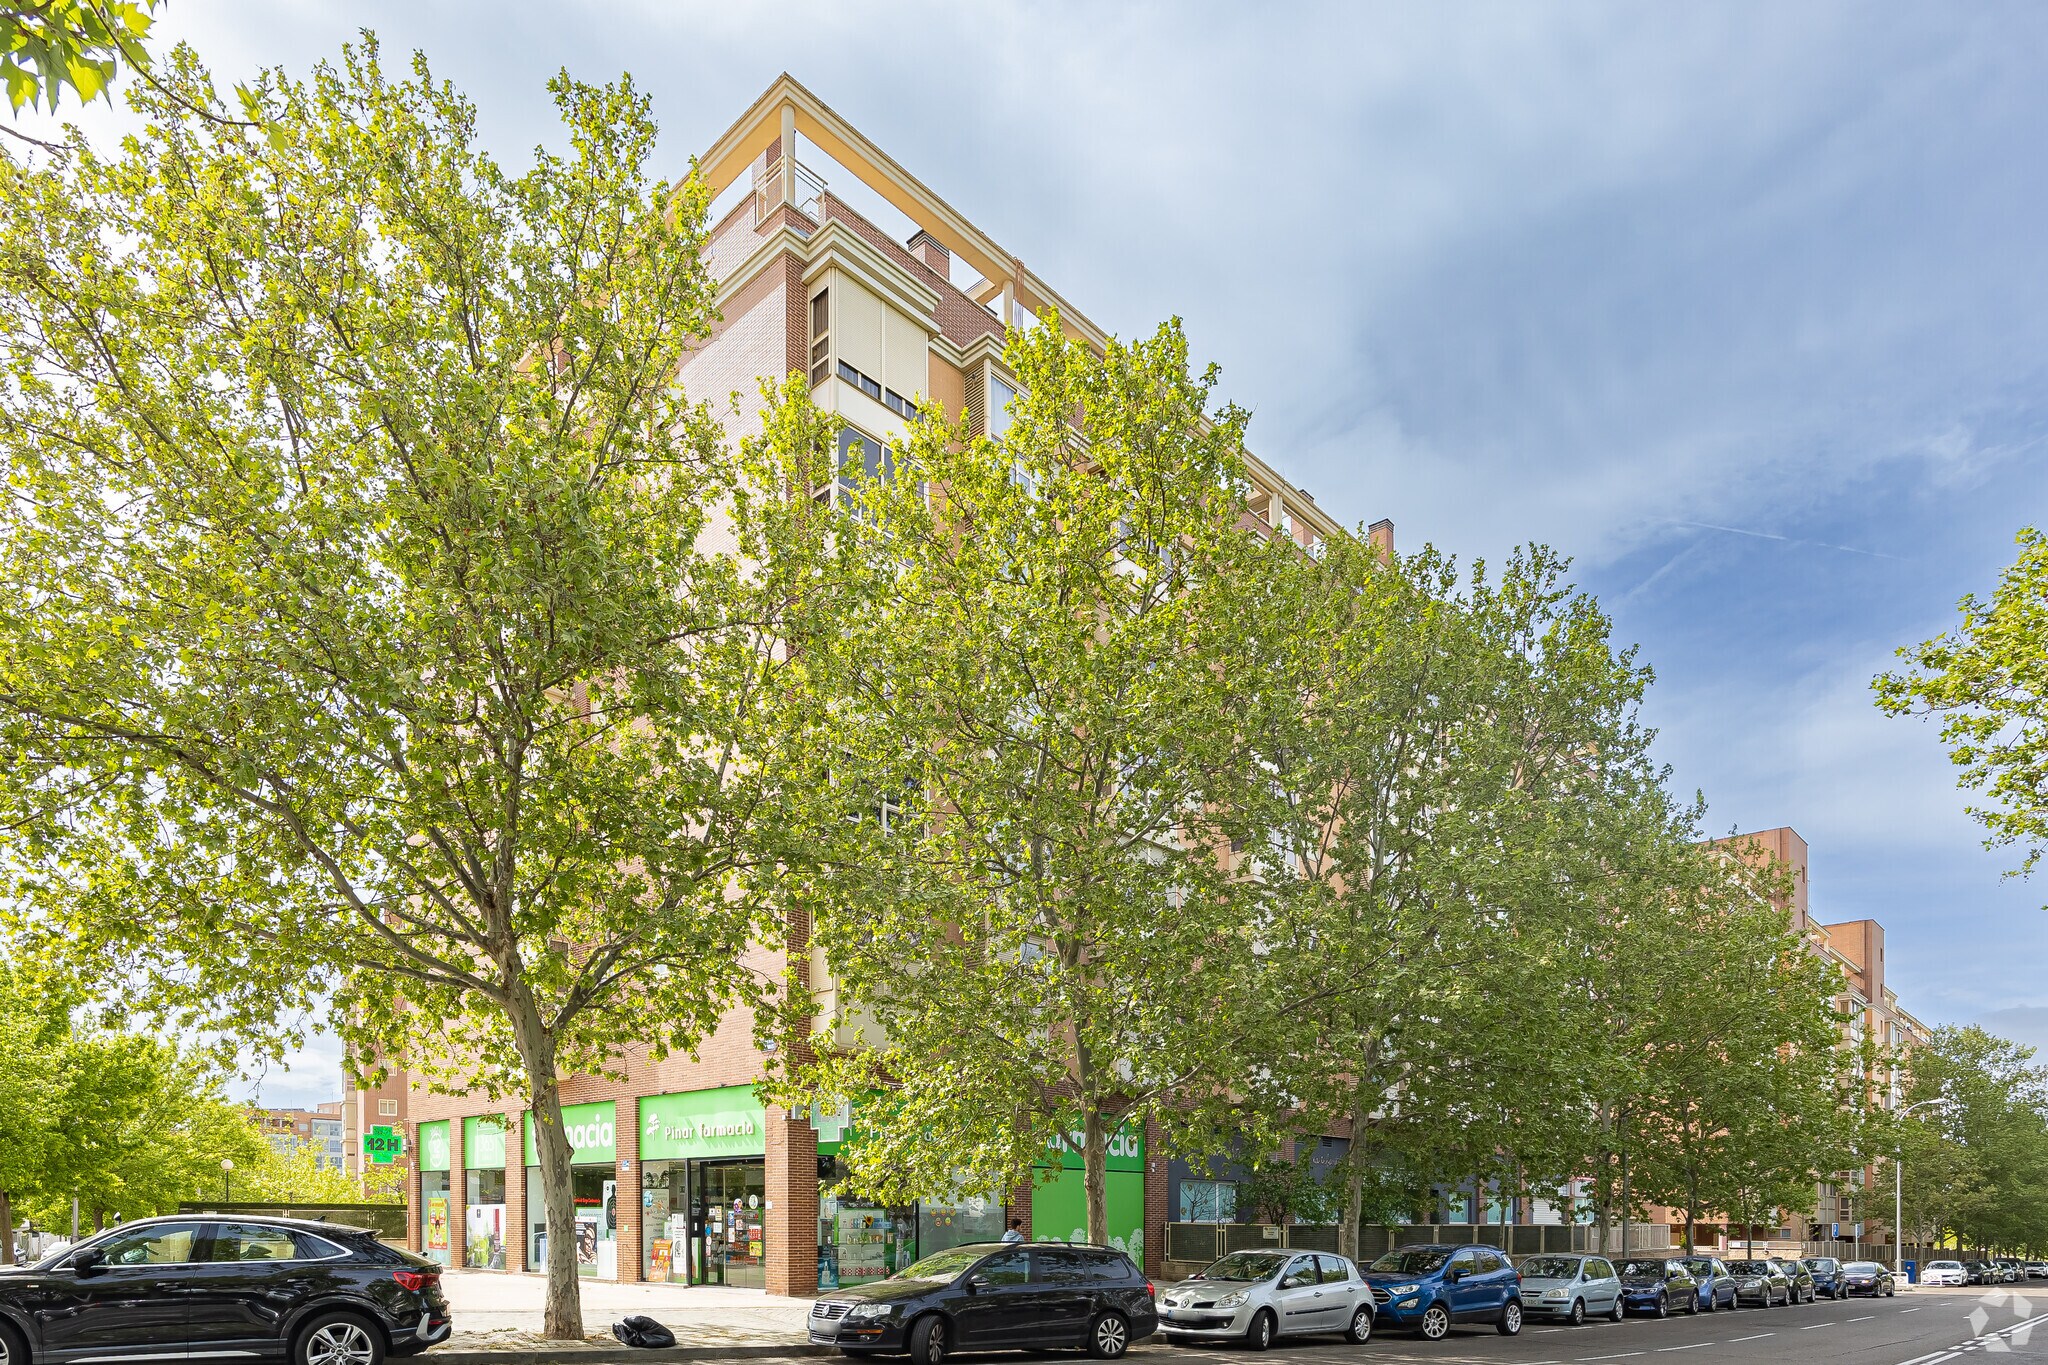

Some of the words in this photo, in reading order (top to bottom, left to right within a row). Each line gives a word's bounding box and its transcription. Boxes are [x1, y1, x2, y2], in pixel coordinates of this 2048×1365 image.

[532, 1113, 613, 1150] acia
[664, 1125, 695, 1140] Pinar
[366, 1138, 385, 1152] 12
[387, 1138, 399, 1152] H
